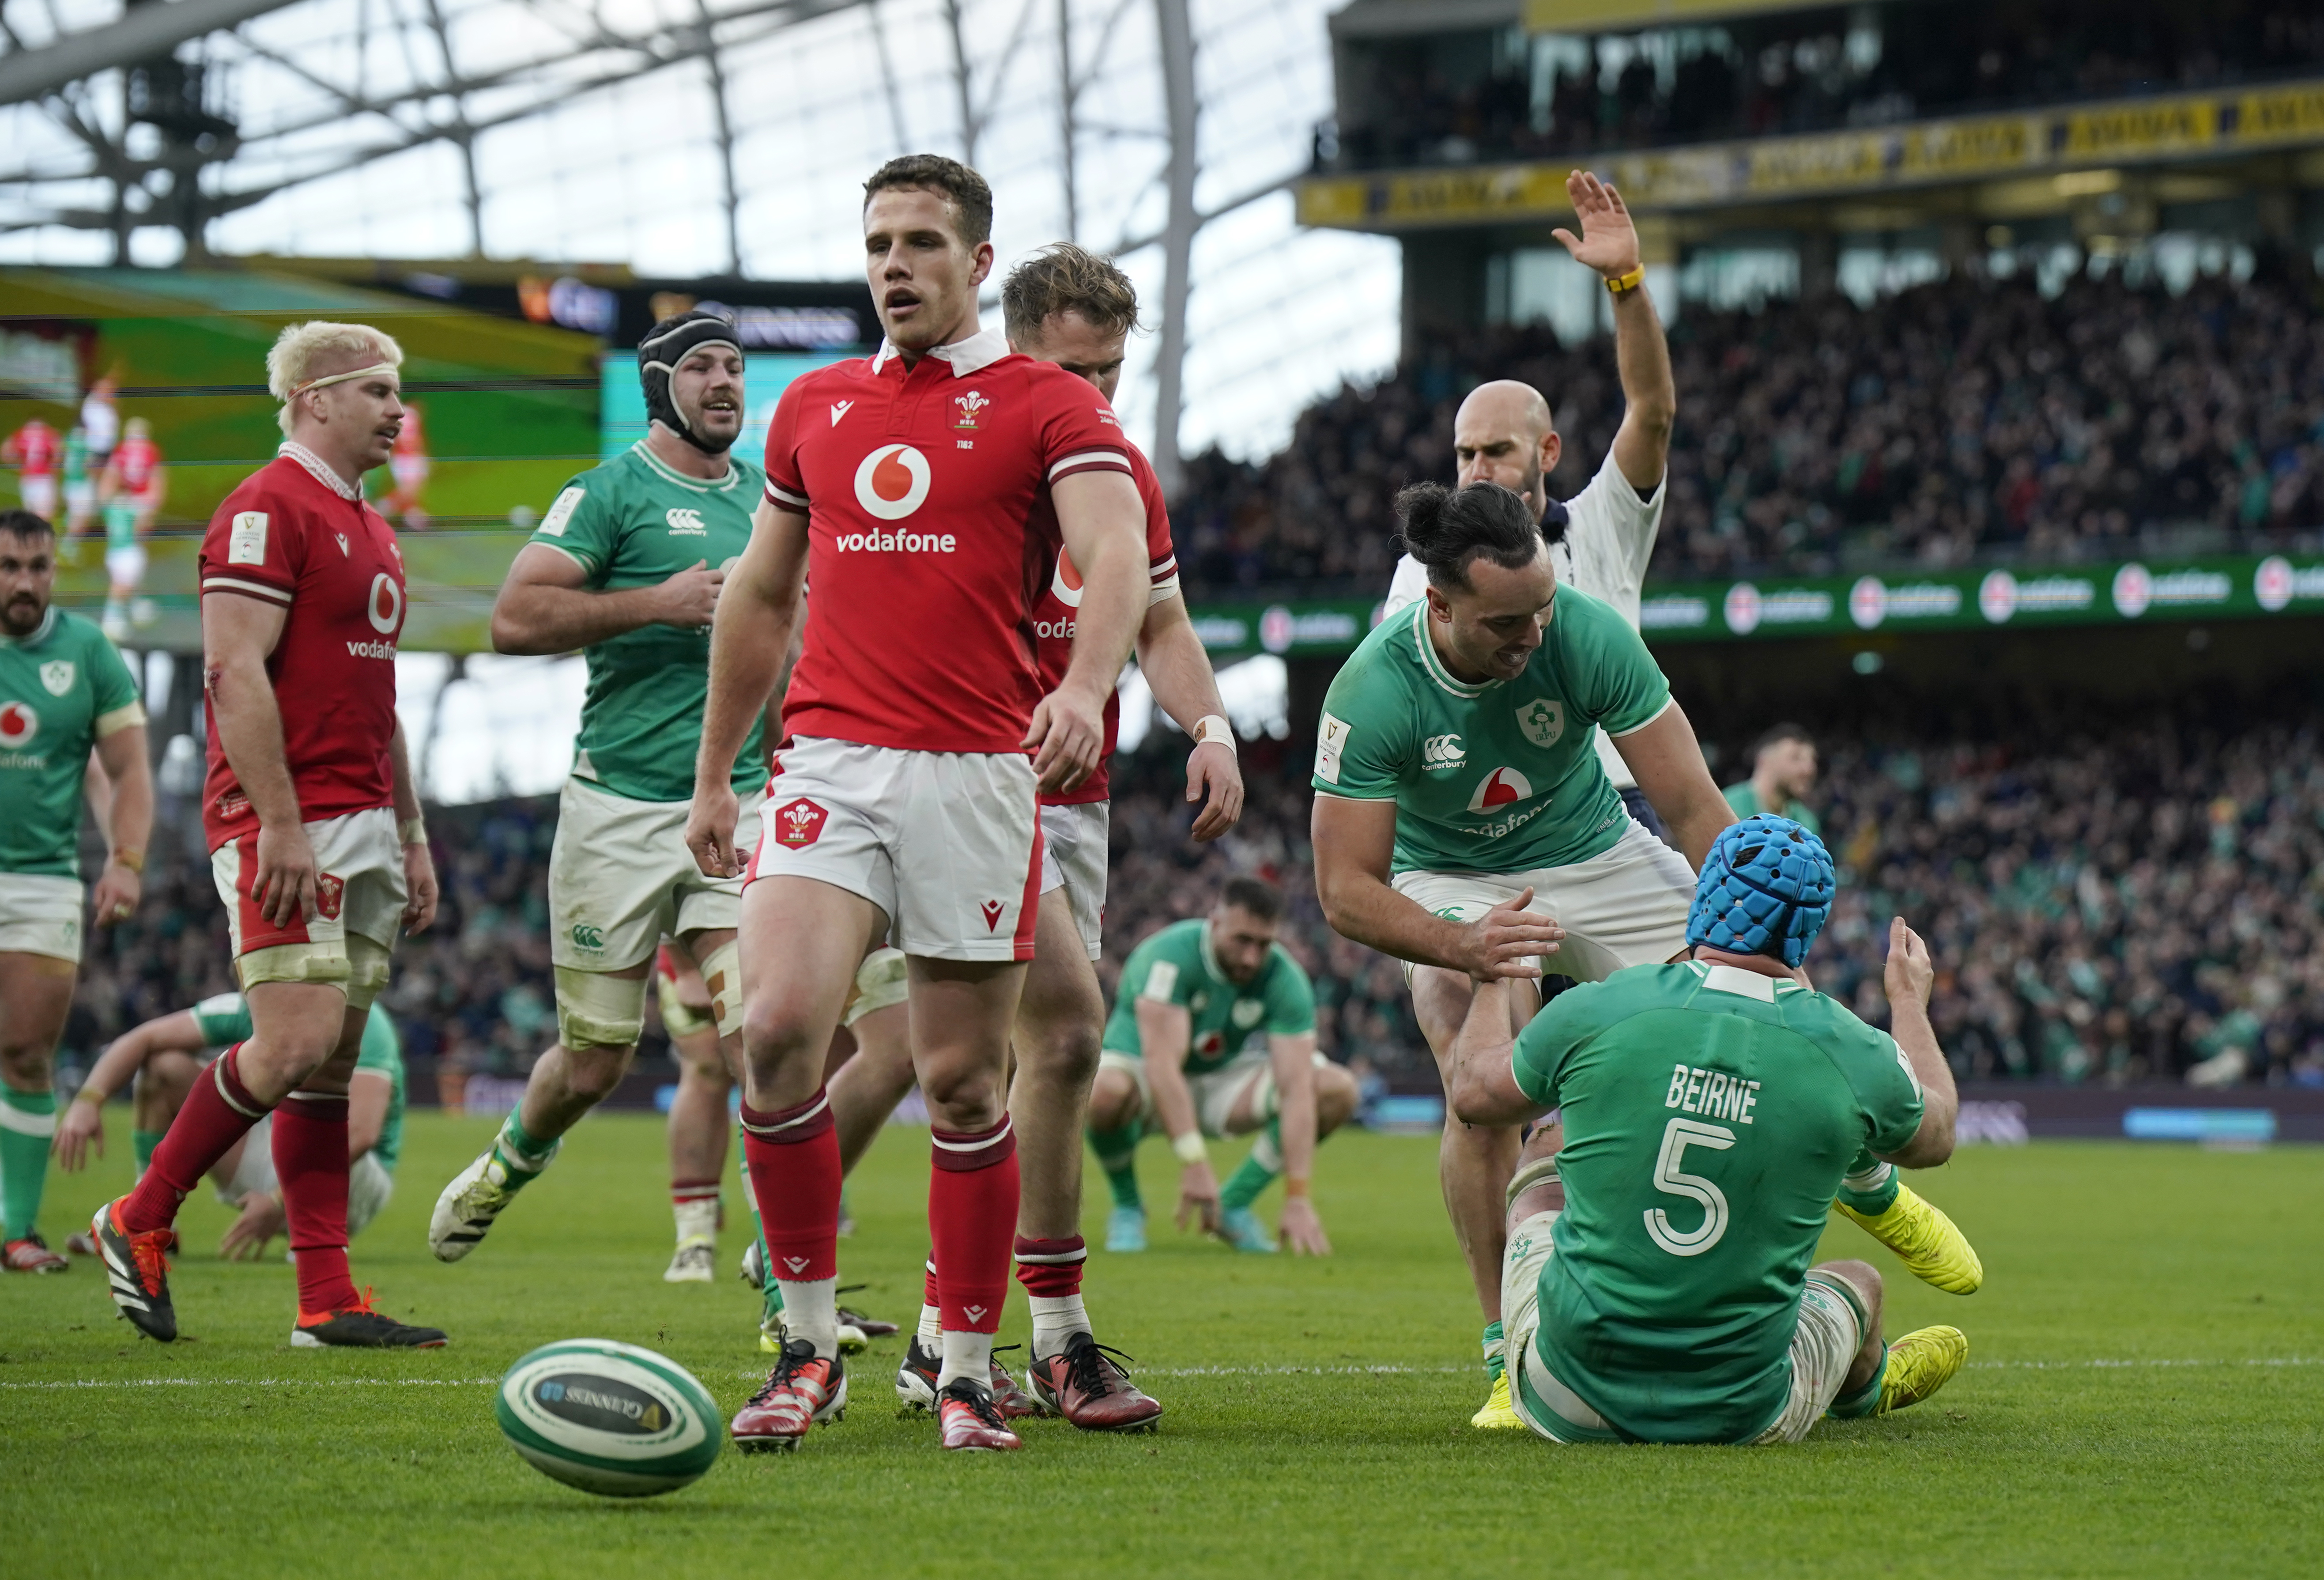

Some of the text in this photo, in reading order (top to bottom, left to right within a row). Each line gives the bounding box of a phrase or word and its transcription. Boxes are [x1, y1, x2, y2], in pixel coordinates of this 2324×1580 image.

[668, 528, 706, 537] canterbury
[836, 527, 956, 553] vodafone
[1320, 737, 1338, 752] GUINNESS
[1422, 760, 1467, 771] canterbury
[1665, 1064, 1761, 1124] BEIRNE
[1643, 1117, 1737, 1256] 5
